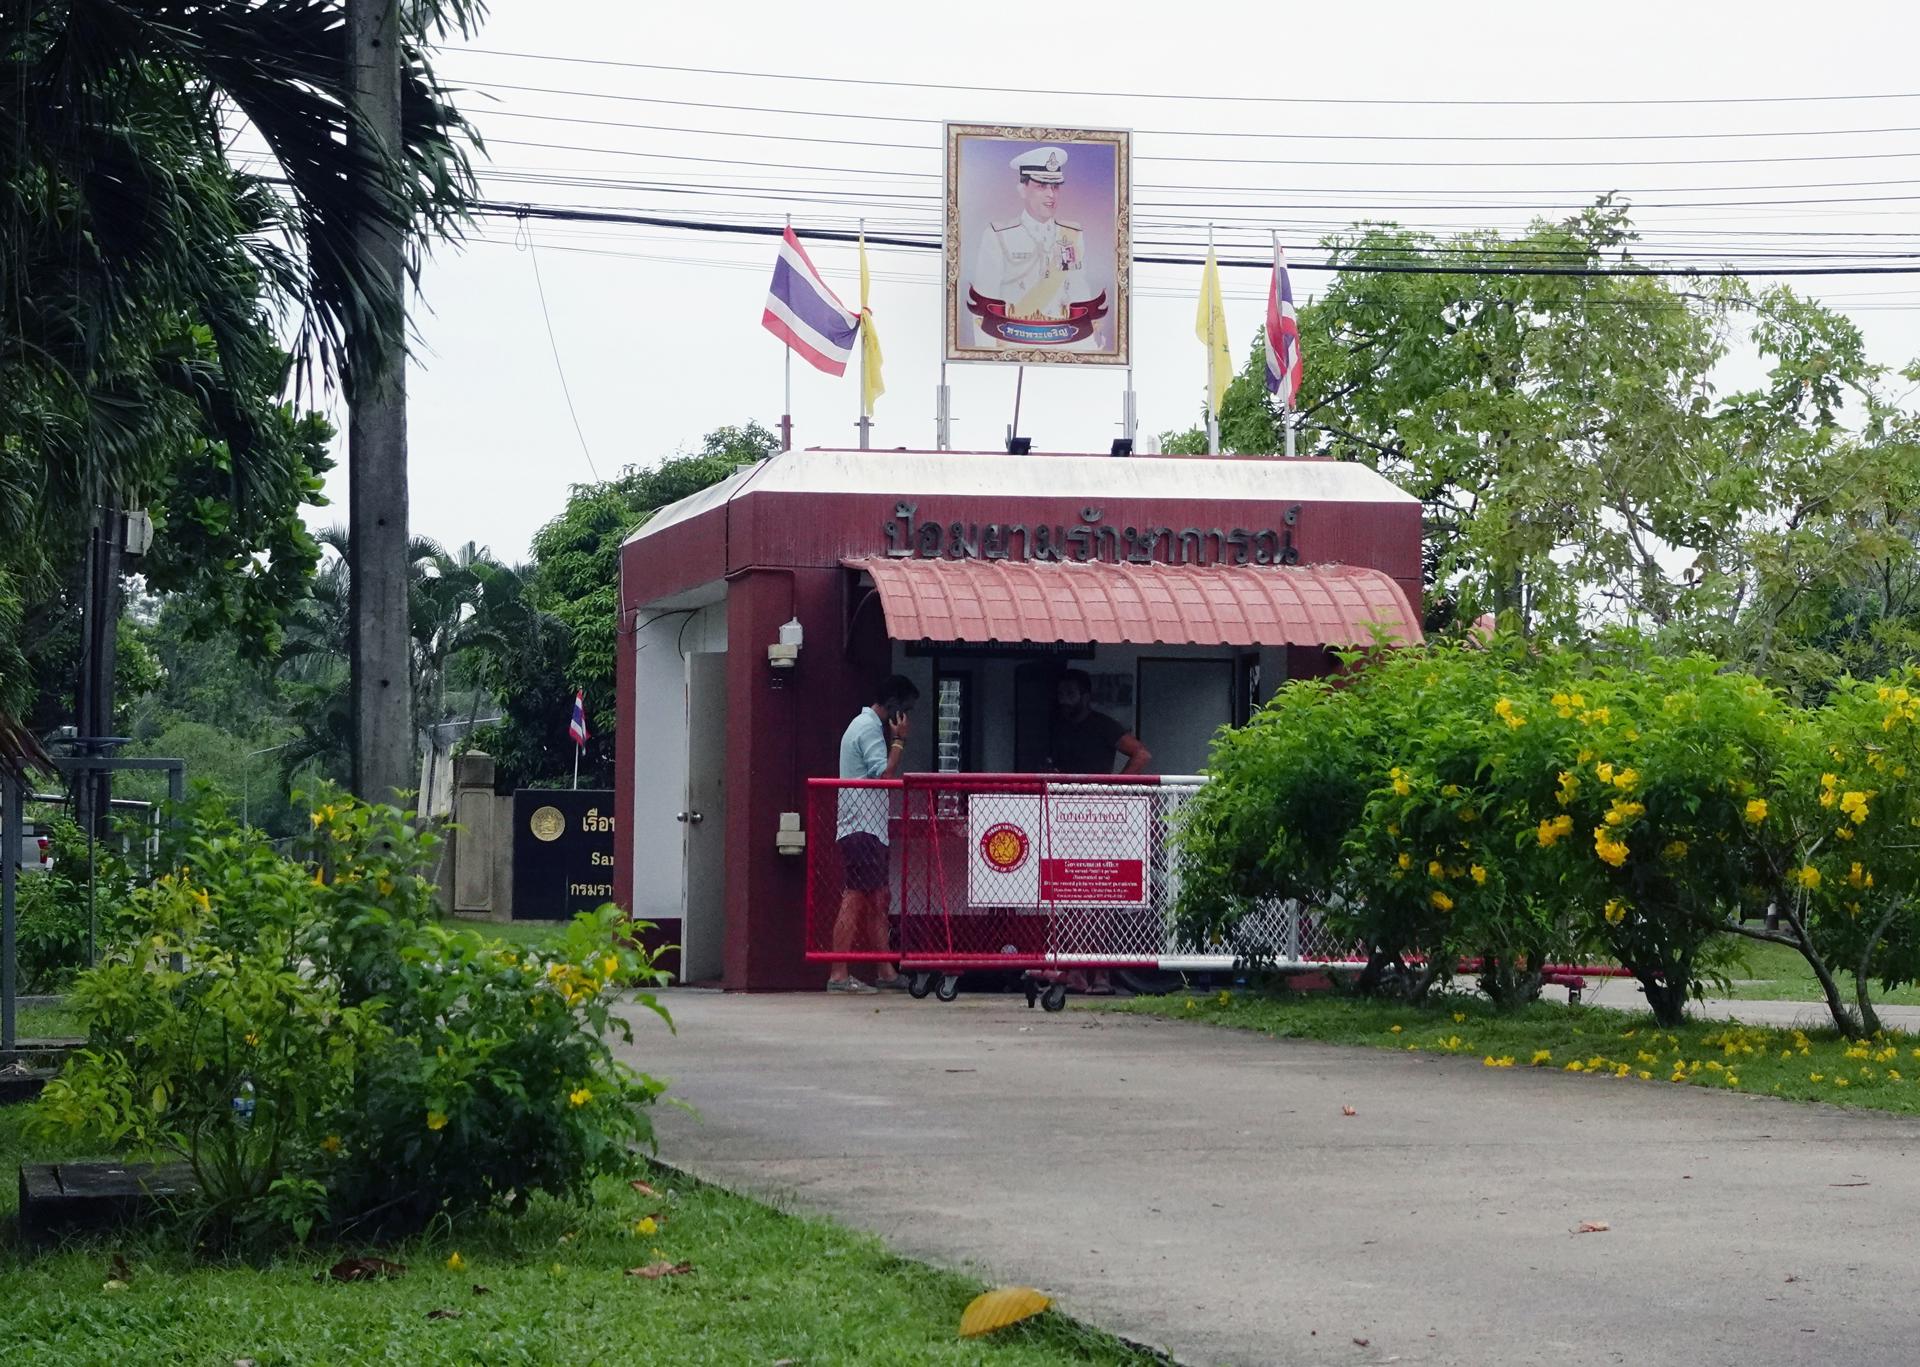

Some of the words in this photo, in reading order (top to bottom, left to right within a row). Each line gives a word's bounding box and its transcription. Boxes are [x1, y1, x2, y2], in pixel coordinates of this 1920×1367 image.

[885, 501, 1302, 564] ป้อมยามรักษาการณ์
[570, 883, 614, 896] กรมรา
